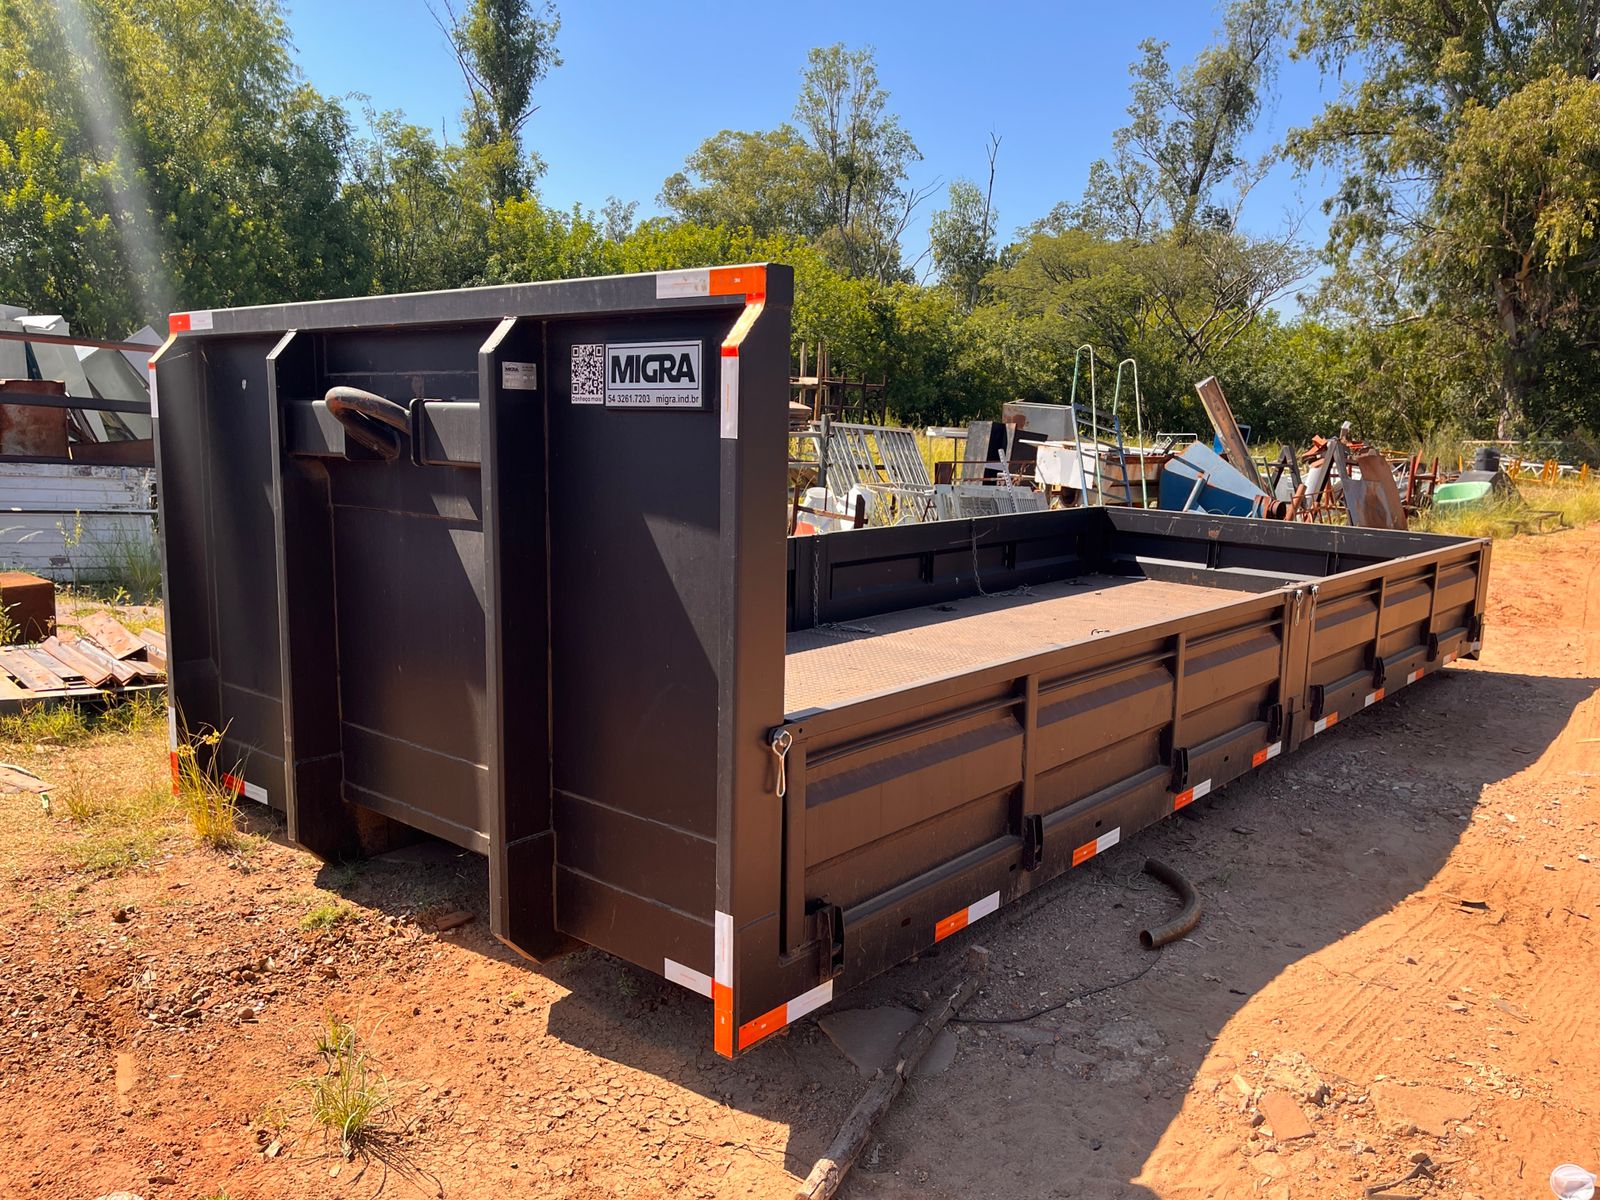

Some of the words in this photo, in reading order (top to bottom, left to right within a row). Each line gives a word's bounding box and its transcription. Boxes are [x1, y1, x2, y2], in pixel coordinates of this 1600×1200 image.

[611, 353, 696, 383] MIGRA
[608, 394, 616, 403] 54
[617, 394, 651, 403] 3261.7203
[655, 394, 699, 406] migra.ind.br
